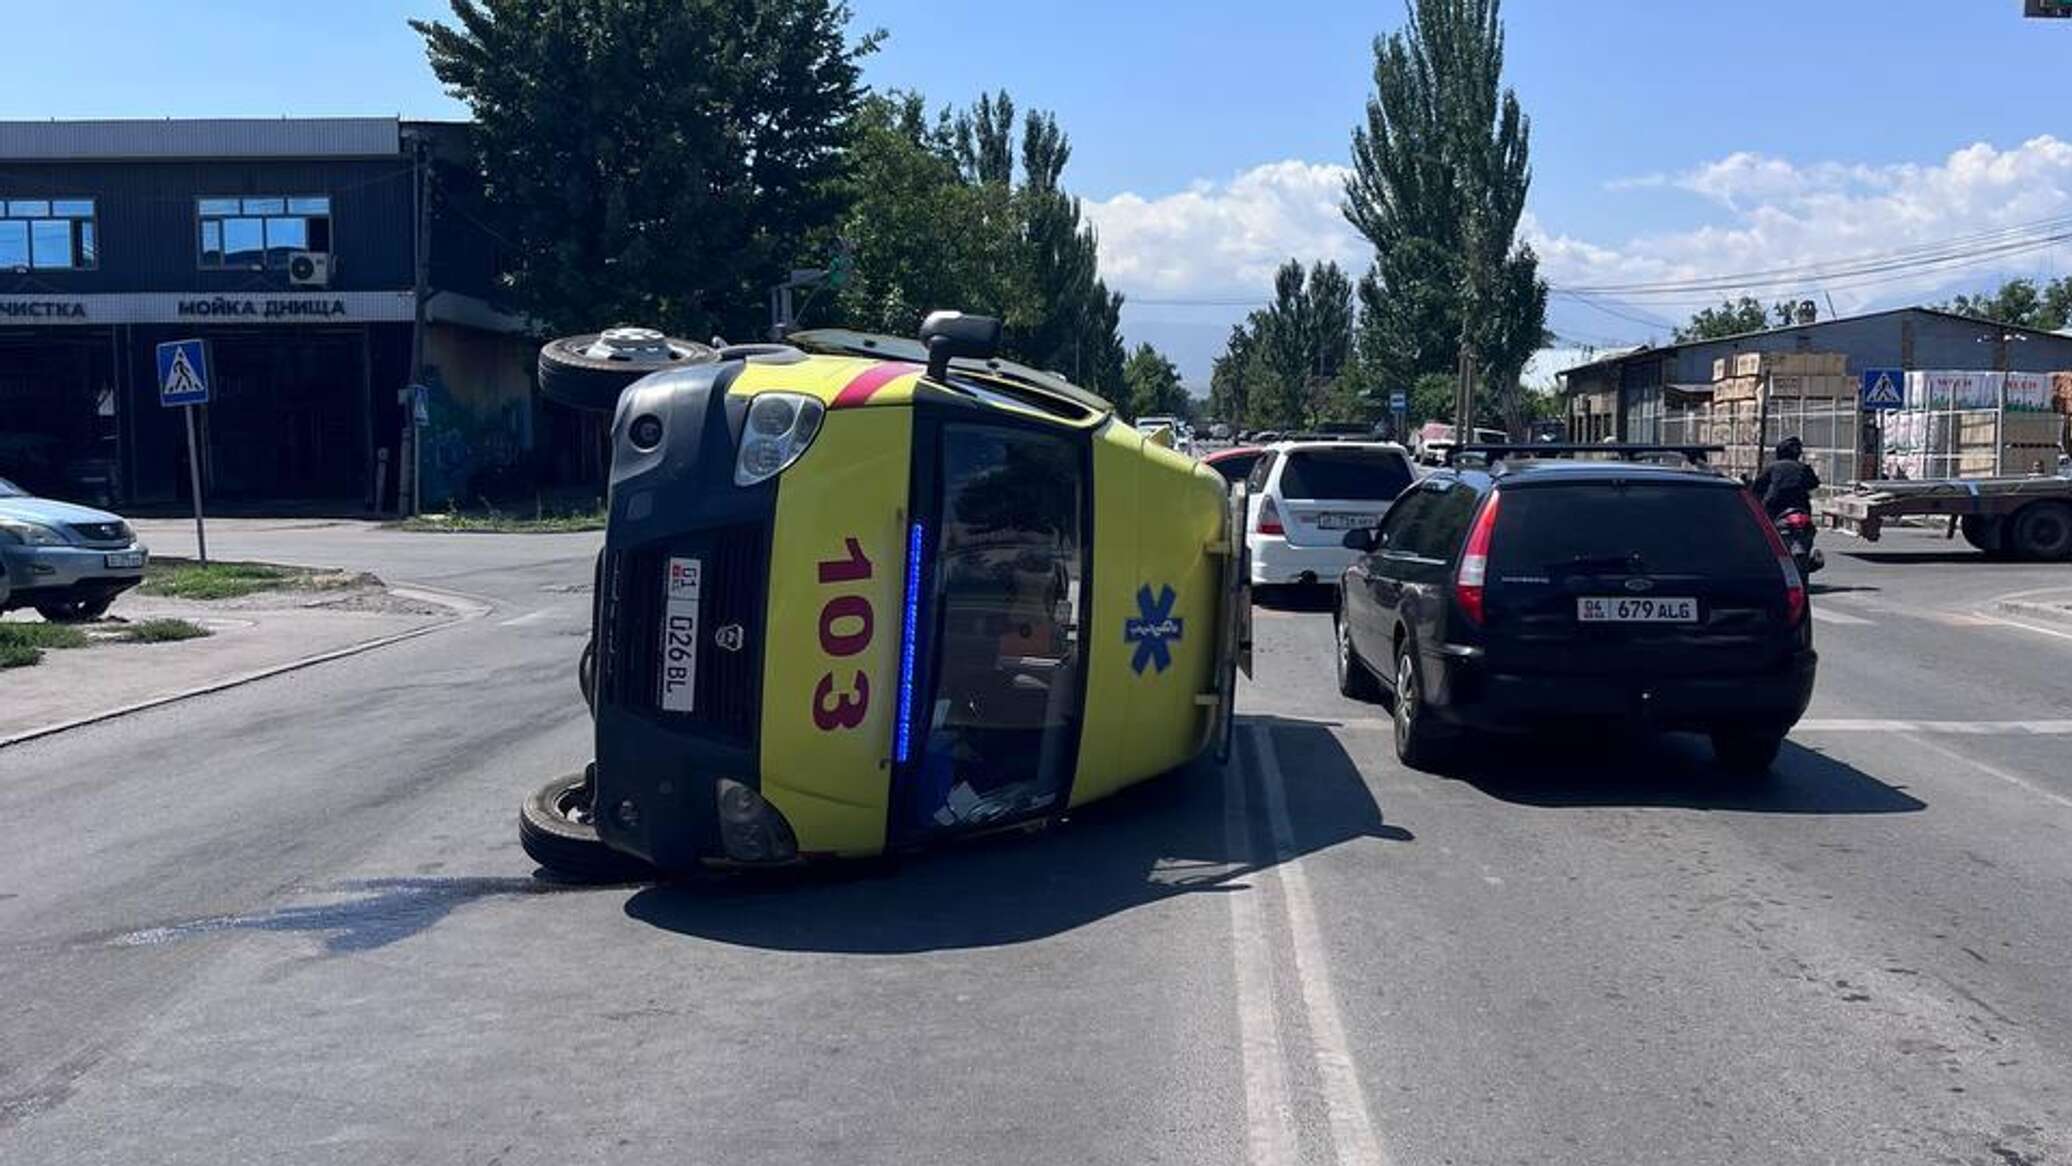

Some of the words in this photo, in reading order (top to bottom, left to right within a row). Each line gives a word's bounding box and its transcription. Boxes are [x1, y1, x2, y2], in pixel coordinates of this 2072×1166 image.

[178, 296, 257, 316] МОЙКА
[264, 300, 346, 318] ДНИЩА
[682, 567, 697, 588] 01
[812, 537, 875, 732] 103
